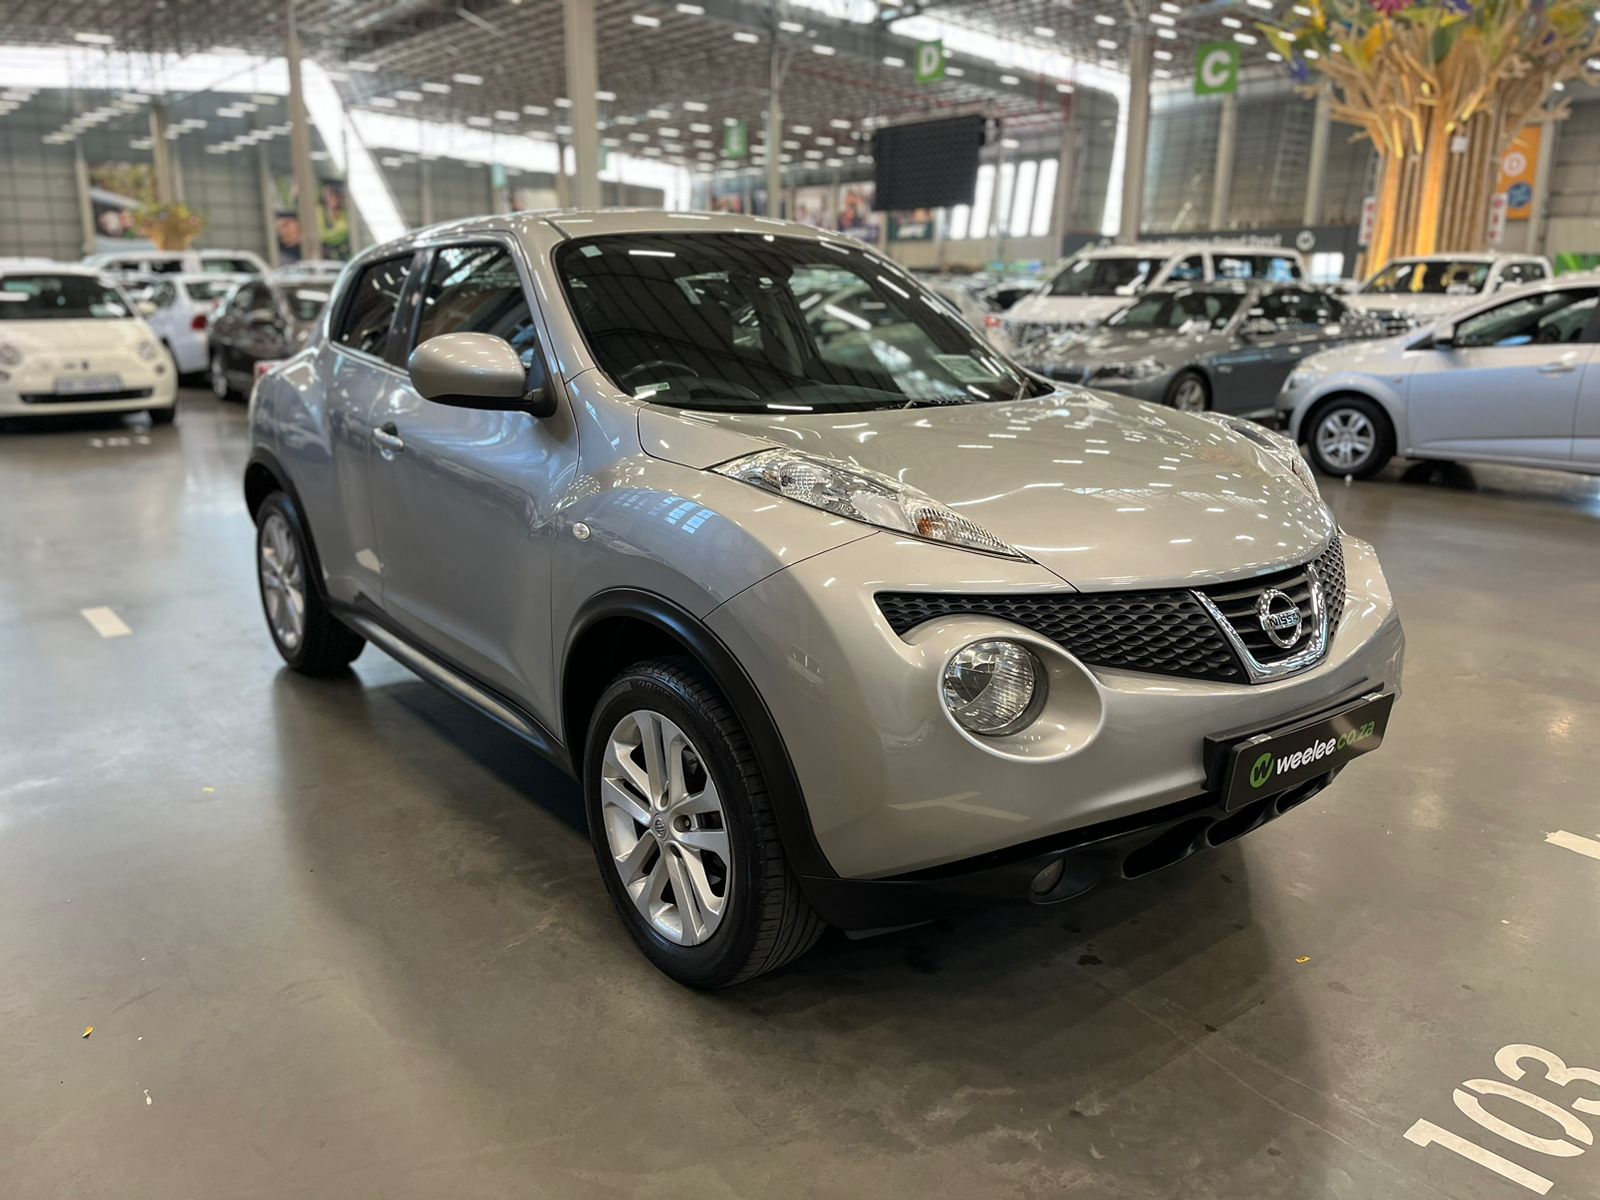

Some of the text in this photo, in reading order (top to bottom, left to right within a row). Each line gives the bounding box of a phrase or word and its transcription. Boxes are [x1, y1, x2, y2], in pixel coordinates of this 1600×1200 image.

[919, 45, 939, 75] D
[1202, 49, 1232, 88] C
[1275, 720, 1376, 775] weelee.co.za
[1403, 1043, 1600, 1196] 103
